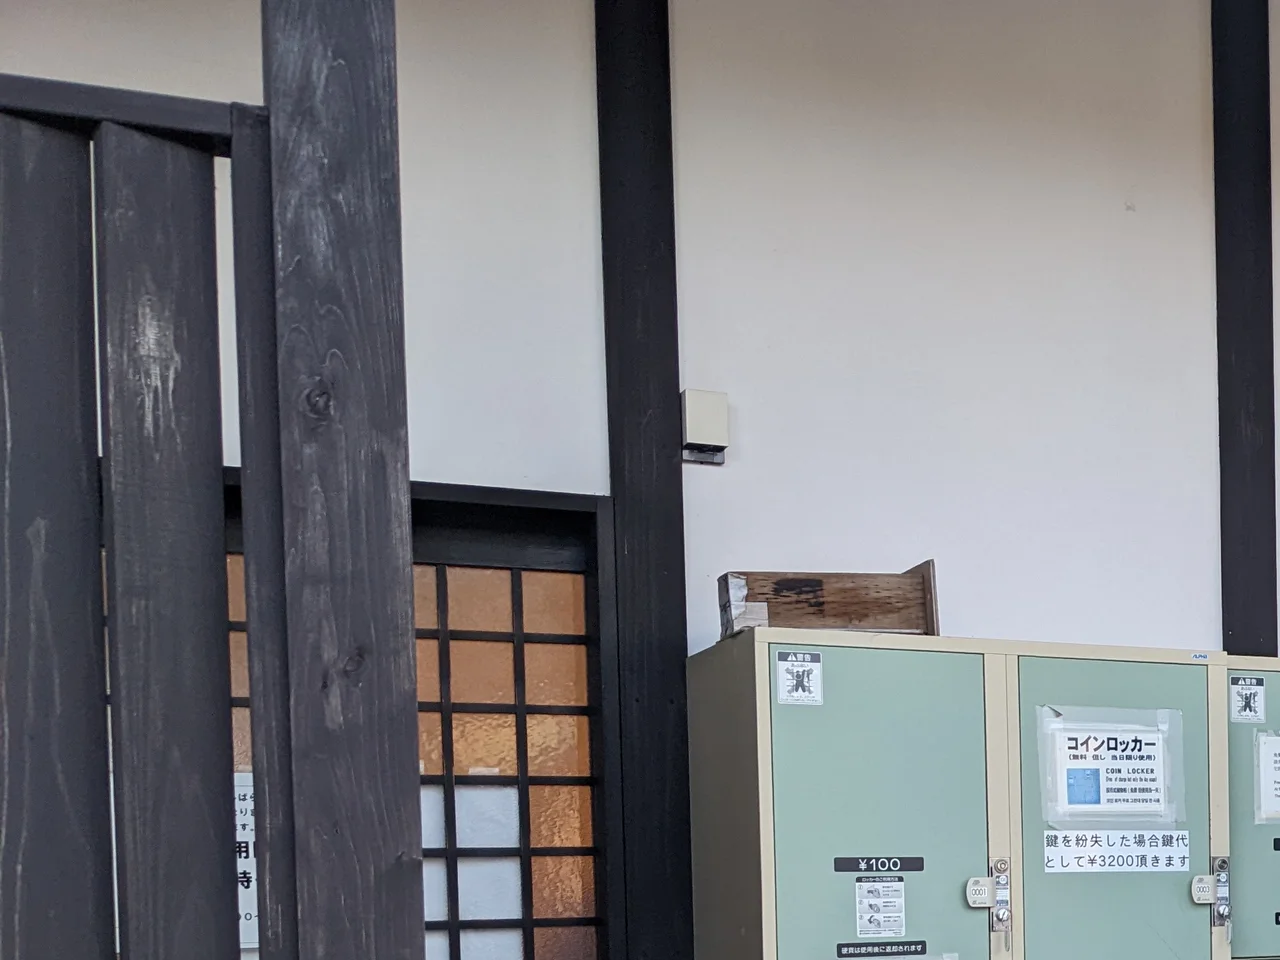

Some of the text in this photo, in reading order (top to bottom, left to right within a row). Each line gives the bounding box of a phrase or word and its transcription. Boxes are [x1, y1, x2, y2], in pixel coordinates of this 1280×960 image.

[1068, 735, 1156, 752] コインロッカー
[1046, 834, 1189, 848] 鍵を紛失した場合鍵代
[859, 858, 900, 871] ¥100
[1045, 854, 1189, 868] として¥3200頂きます
